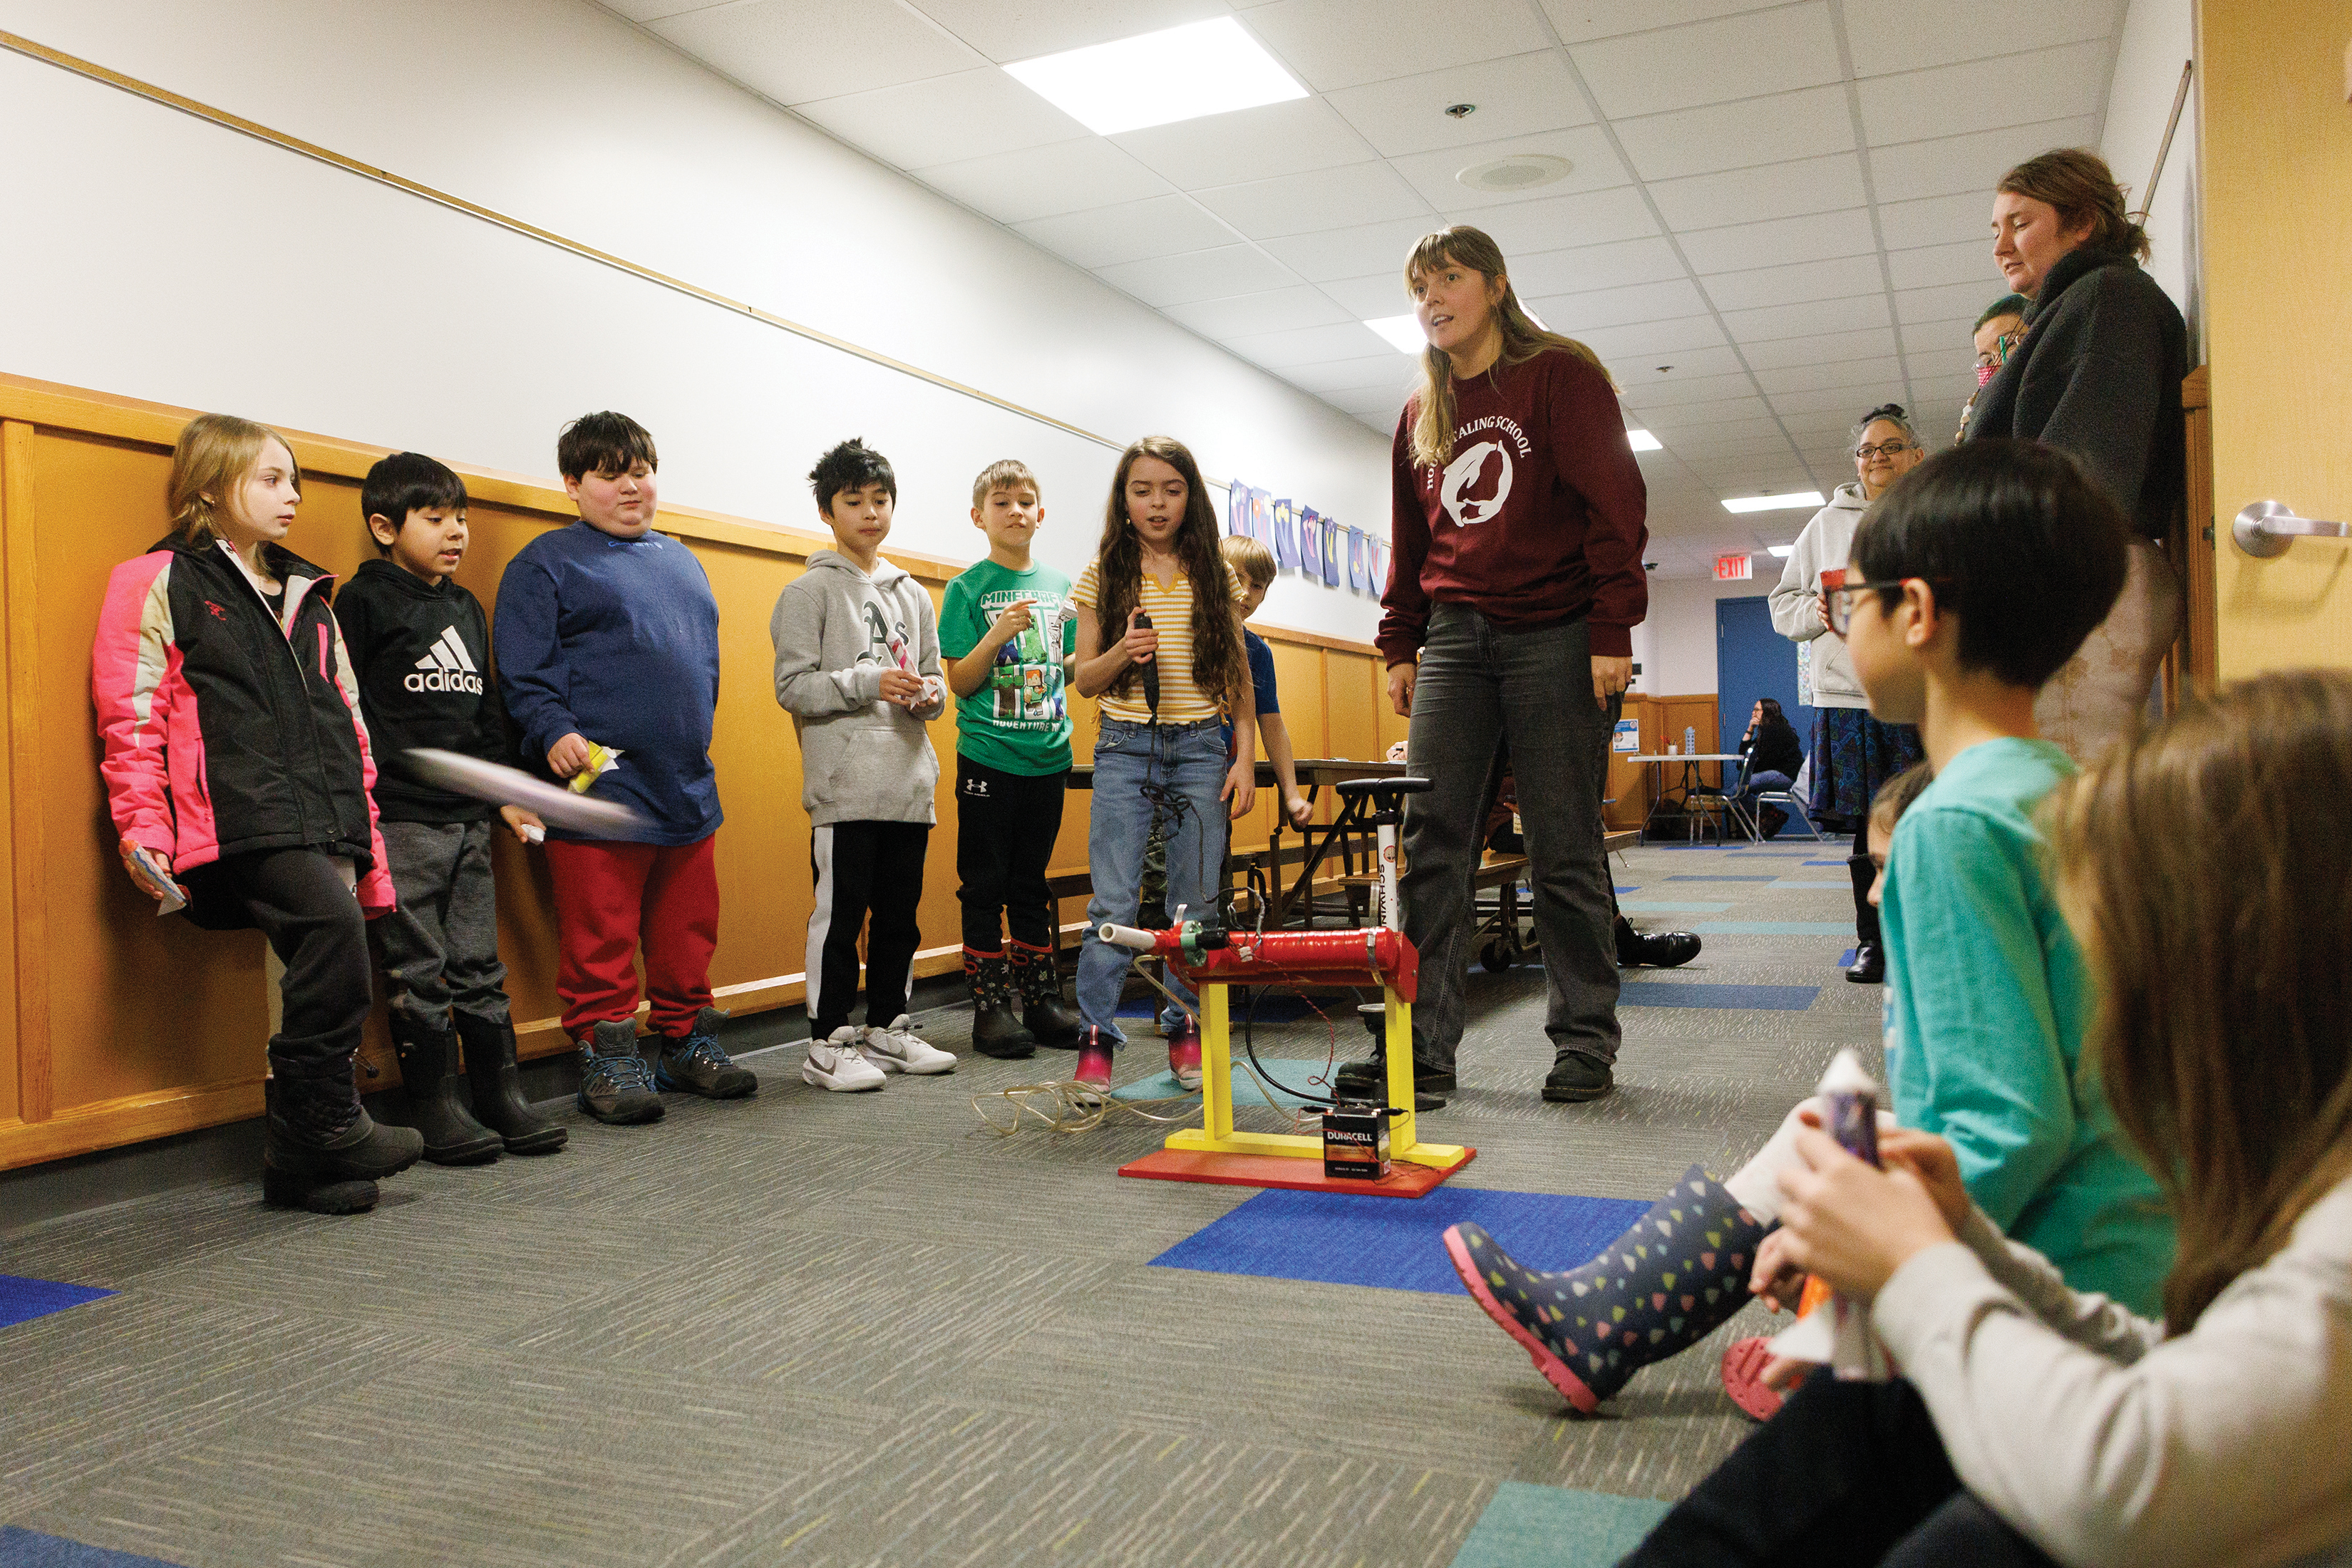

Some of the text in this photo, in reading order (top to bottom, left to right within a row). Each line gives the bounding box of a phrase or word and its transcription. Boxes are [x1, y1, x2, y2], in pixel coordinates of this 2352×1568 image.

[1495, 416, 1532, 458] SCHOOL
[1718, 557, 1745, 579] EXIT
[403, 667, 483, 696] adidas
[993, 720, 1049, 732] ADVENTURE
[1327, 1131, 1373, 1142] DURACELL
